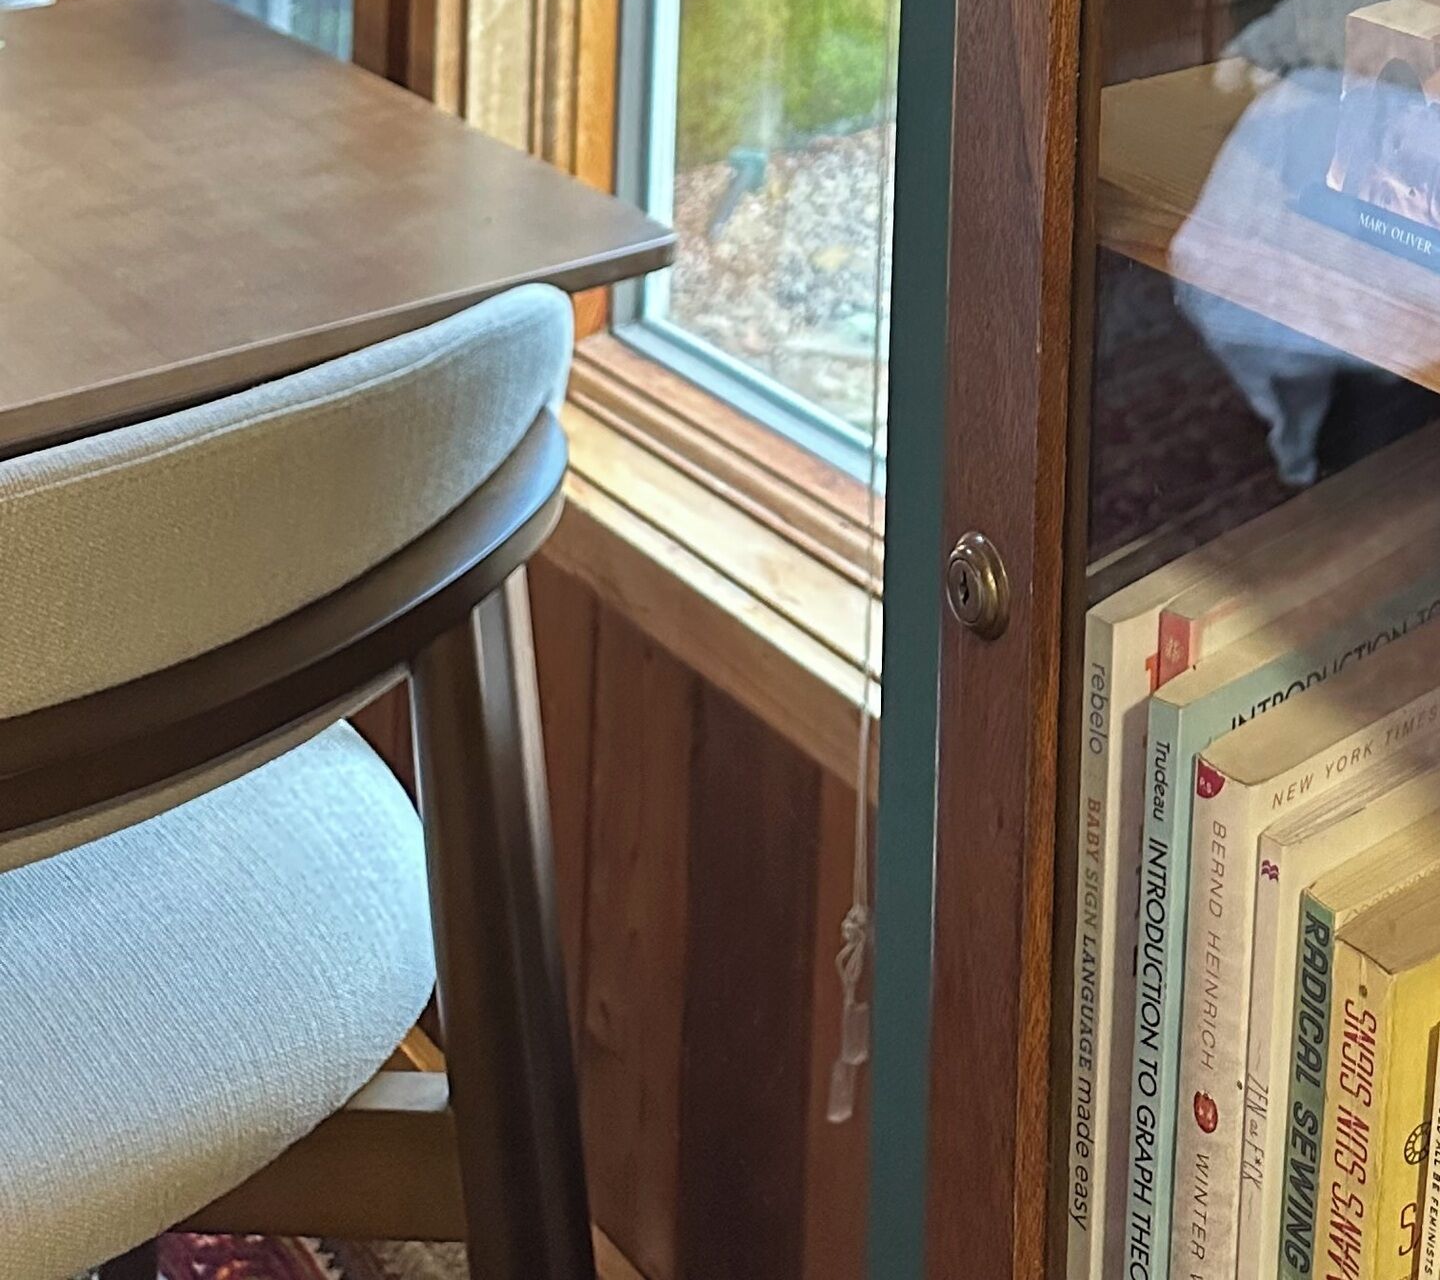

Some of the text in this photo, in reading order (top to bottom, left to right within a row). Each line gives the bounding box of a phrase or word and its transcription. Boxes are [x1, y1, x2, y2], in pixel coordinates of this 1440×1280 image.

[1358, 211, 1388, 237] MARY
[1391, 226, 1433, 256] OLIVER
[1152, 741, 1171, 822] Trudeau
[1272, 774, 1315, 811] NEW
[1325, 743, 1374, 780] YORK
[1385, 707, 1440, 747] TIMES
[1208, 820, 1228, 919] BERND
[1068, 663, 1106, 1232] rebelo BABY SIGN LANGUAGE made easy
[1137, 838, 1169, 1051] INTRODUCTION
[1201, 930, 1222, 1071] HEINRICH
[1138, 1057, 1158, 1097] TO
[1245, 1072, 1268, 1120] ZEN
[1285, 913, 1330, 1273] RADICAL SEWING
[1340, 998, 1377, 1108] SIGNS
[1130, 1105, 1157, 1203] GRAPH
[1335, 1104, 1371, 1186] SUN
[1431, 1172, 1440, 1192] BE
[1190, 1153, 1210, 1261] WINTER
[1424, 1195, 1439, 1276] FEMINISTS
